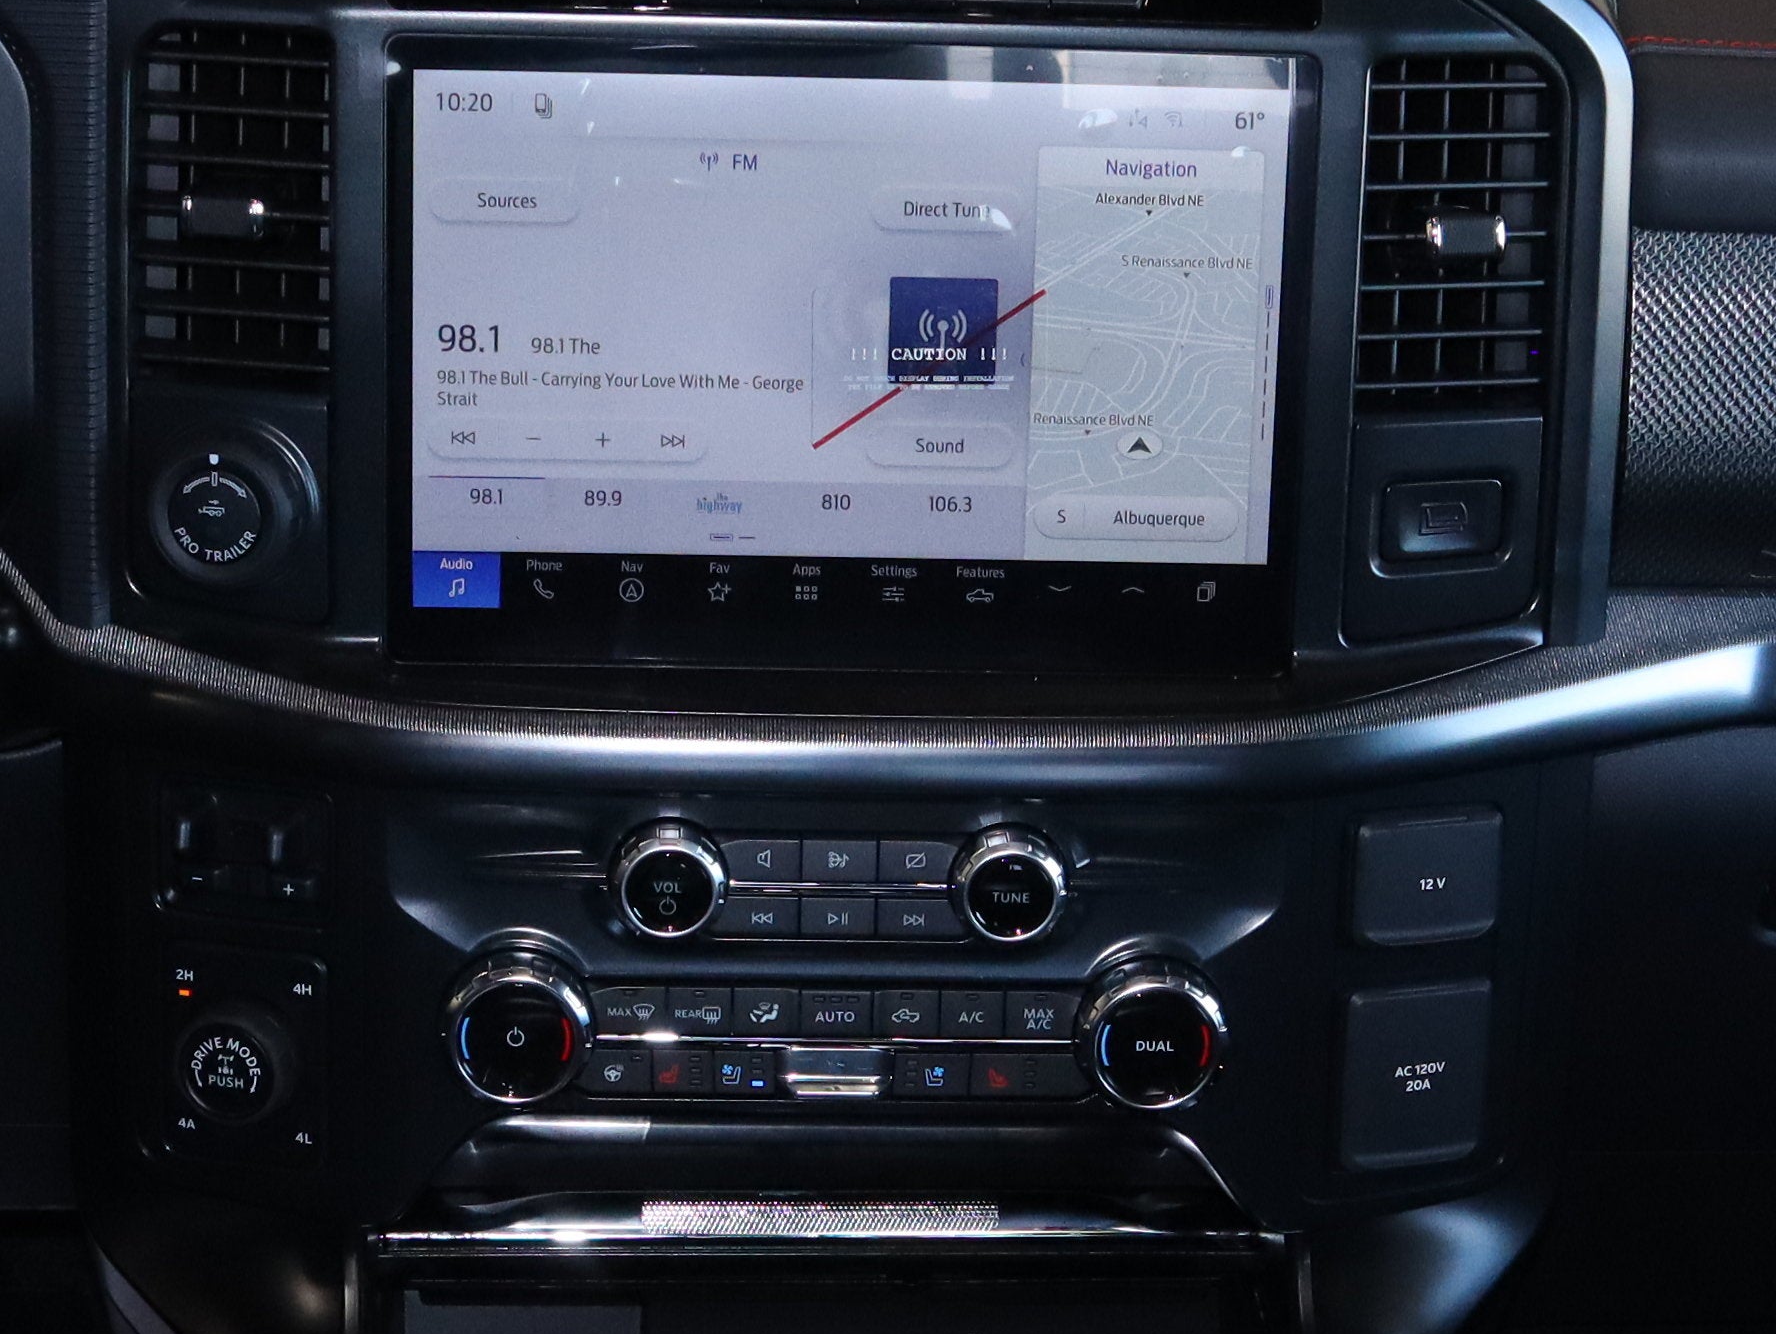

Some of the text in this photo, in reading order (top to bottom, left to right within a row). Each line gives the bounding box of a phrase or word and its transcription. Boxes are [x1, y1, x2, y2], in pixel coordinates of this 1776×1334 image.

[435, 92, 494, 113] 10:20
[732, 154, 759, 172] FM
[1105, 158, 1198, 181] Navigation
[477, 192, 538, 209] Sources
[1095, 193, 1205, 207] Alexander Blvd NE
[904, 201, 948, 217] Direct
[1121, 255, 1253, 270] S Renaissance Blvd NE
[437, 324, 601, 356] 98.1 98.1 The
[890, 347, 968, 362] CAUTION
[436, 370, 804, 393] 98.1 The Bull Carrying Your Love With Me George
[436, 391, 478, 407] Strait
[1033, 413, 1154, 428] Renaissance Blvd NE
[914, 438, 964, 455] Sound
[469, 488, 504, 505] 98.1
[584, 490, 622, 507] 89.9
[821, 494, 852, 511] 810
[928, 495, 973, 513] 106.3
[1056, 509, 1206, 528] S Albuquerque
[174, 526, 258, 563] PRO TRAILER
[439, 557, 474, 571] Audio
[525, 558, 563, 572] Phone
[620, 560, 644, 573] Nav
[709, 561, 730, 574] Fav
[792, 563, 822, 579] Apps
[870, 564, 918, 580] Settings
[955, 565, 1006, 580] Features
[653, 881, 682, 894] VOL
[1418, 876, 1448, 891] 12 V
[991, 891, 1031, 905] TUNE
[175, 967, 195, 983] 2H
[292, 982, 313, 997] 4H
[606, 1006, 632, 1018] MAX
[674, 1008, 703, 1019] REAR
[814, 1011, 856, 1023] AUTO
[958, 1010, 984, 1024] A/C
[1023, 1008, 1055, 1020] MAX
[1026, 1018, 1052, 1031] A/C
[1135, 1039, 1175, 1053] DUAL
[190, 1035, 261, 1076] DRIVE MODE
[1394, 1061, 1446, 1079] AC 120V
[207, 1073, 245, 1090] PUSH
[1405, 1077, 1432, 1093] 20A
[177, 1117, 196, 1131] 4A
[295, 1131, 314, 1145] 4L
